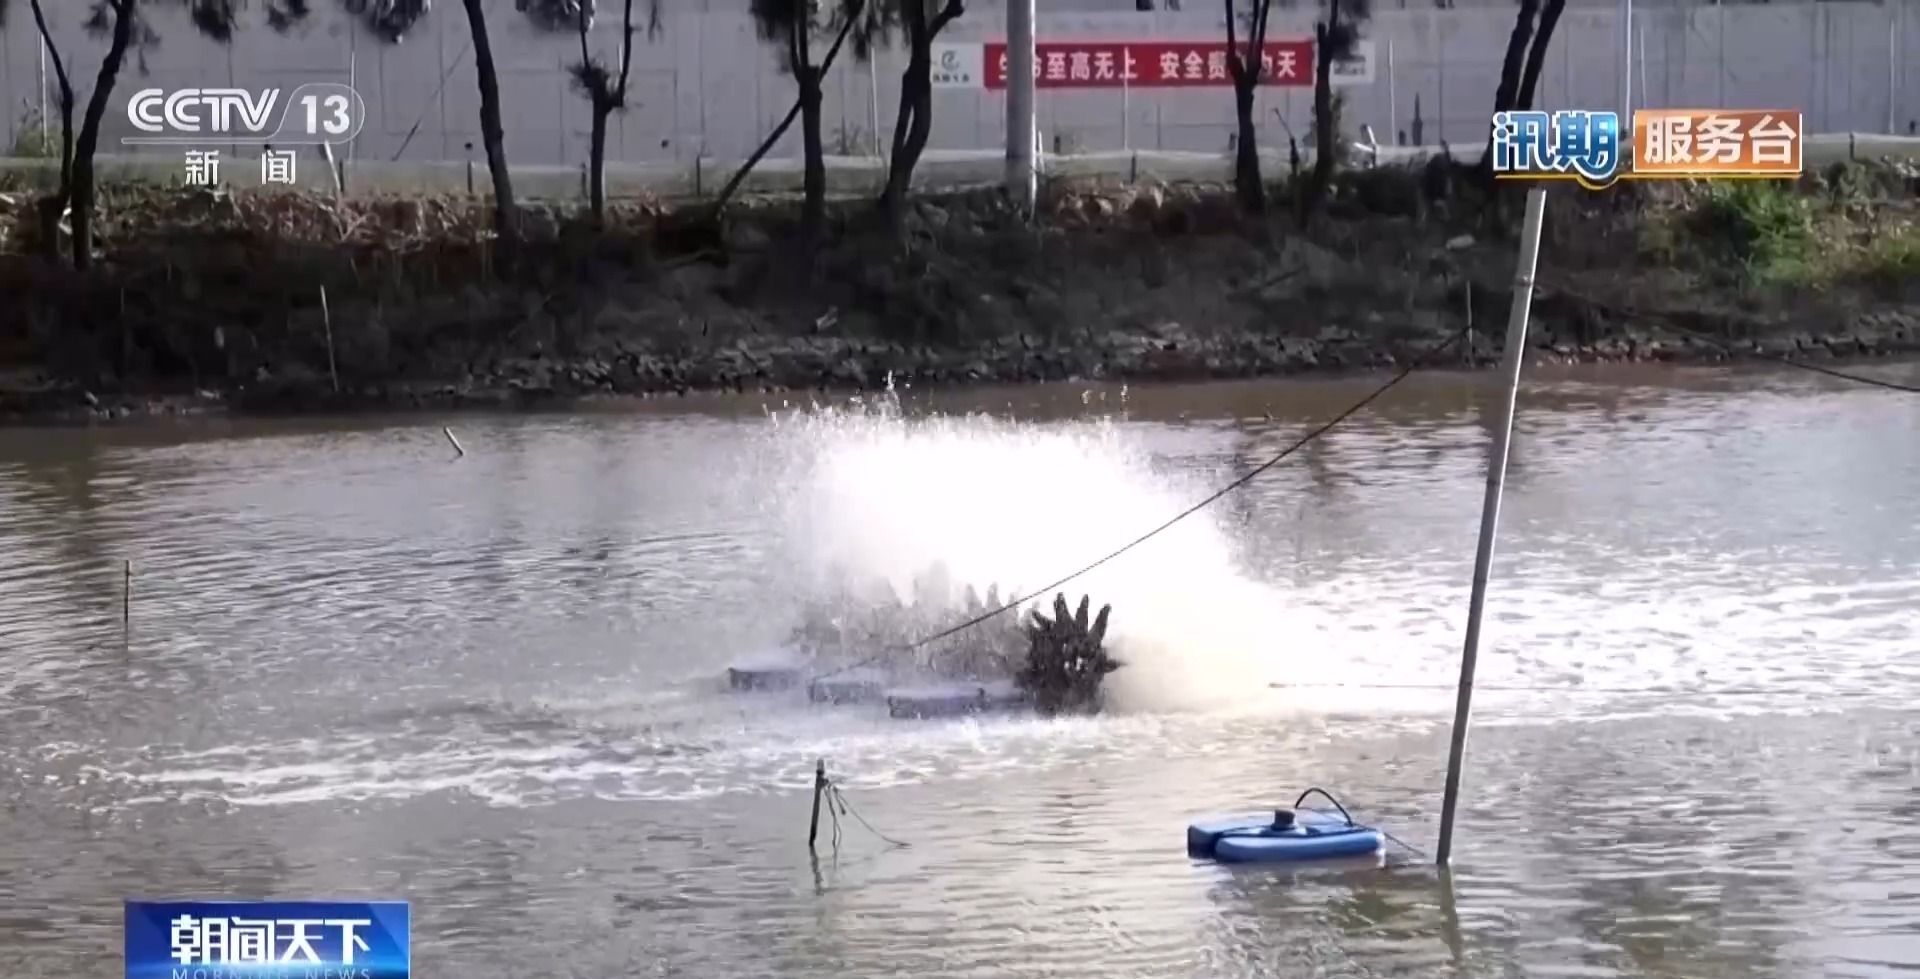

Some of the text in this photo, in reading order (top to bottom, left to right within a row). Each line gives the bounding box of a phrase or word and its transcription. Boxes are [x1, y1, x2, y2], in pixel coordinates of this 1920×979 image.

[1159, 50, 1297, 80] 安全责为天
